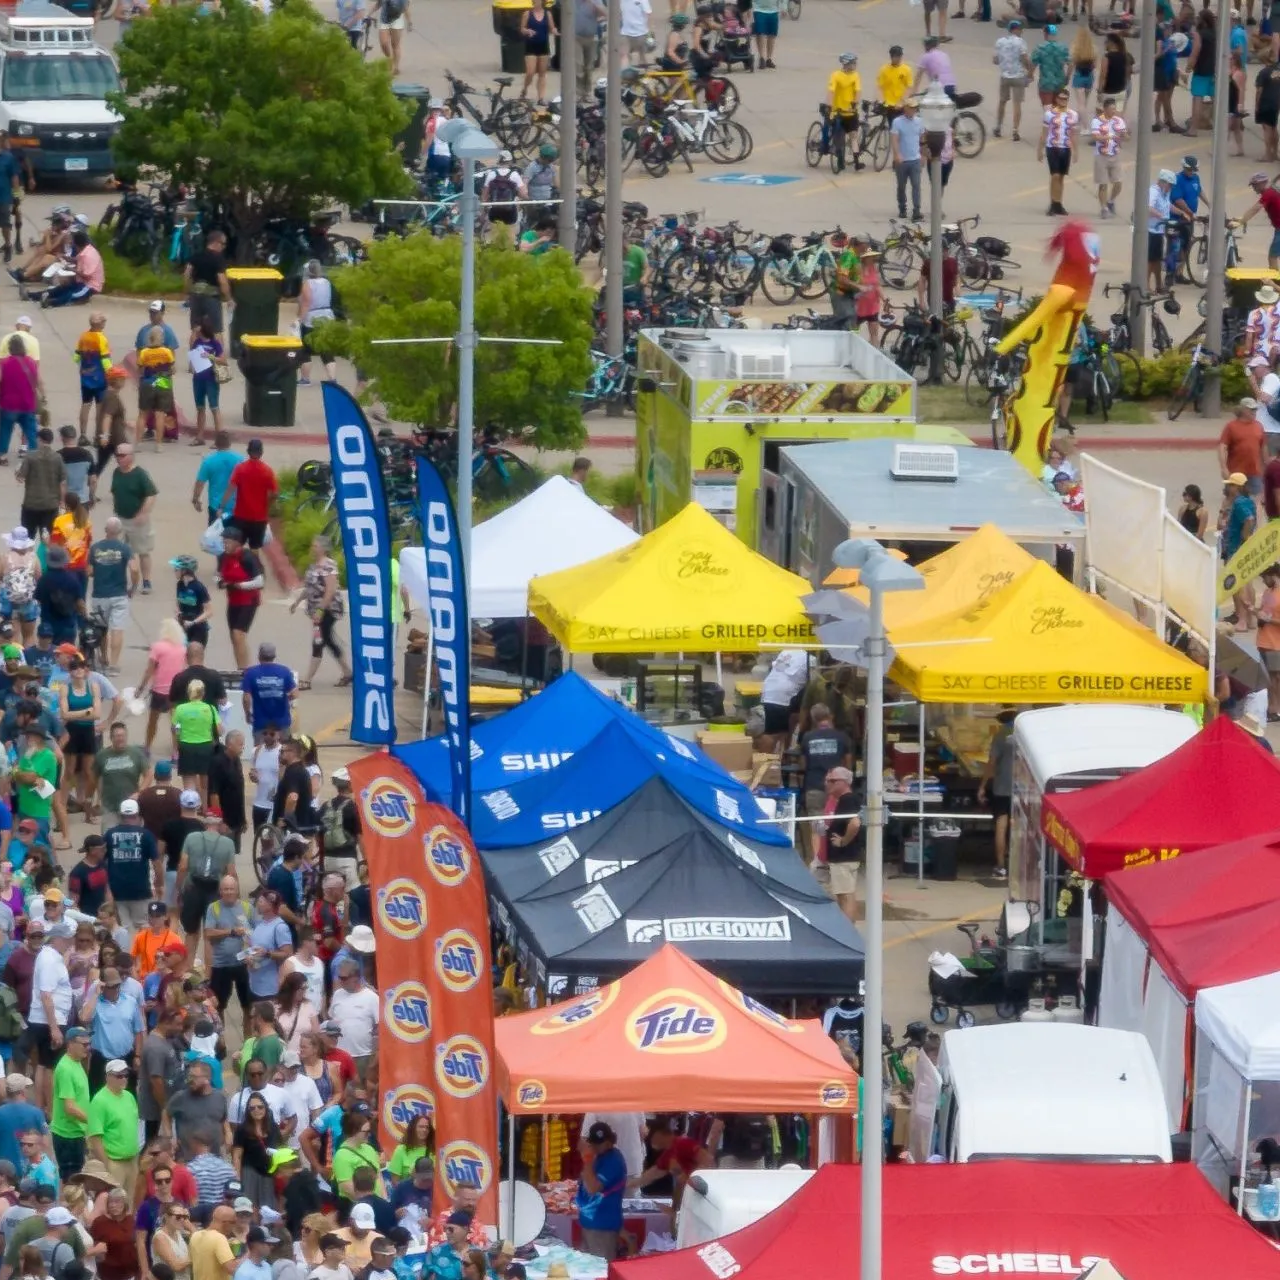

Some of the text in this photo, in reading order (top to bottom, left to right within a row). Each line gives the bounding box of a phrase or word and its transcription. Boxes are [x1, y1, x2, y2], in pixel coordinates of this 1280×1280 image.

[588, 625, 618, 640] SAY
[628, 626, 691, 641] CHEESE
[701, 624, 767, 639] GRILLED
[942, 675, 1193, 691] SAY CHEESE GRILLED CHEESE
[669, 921, 787, 939] BIKEIOWA
[635, 1005, 716, 1050] Tide
[519, 1087, 545, 1103] Tide
[823, 1087, 849, 1103] Tide
